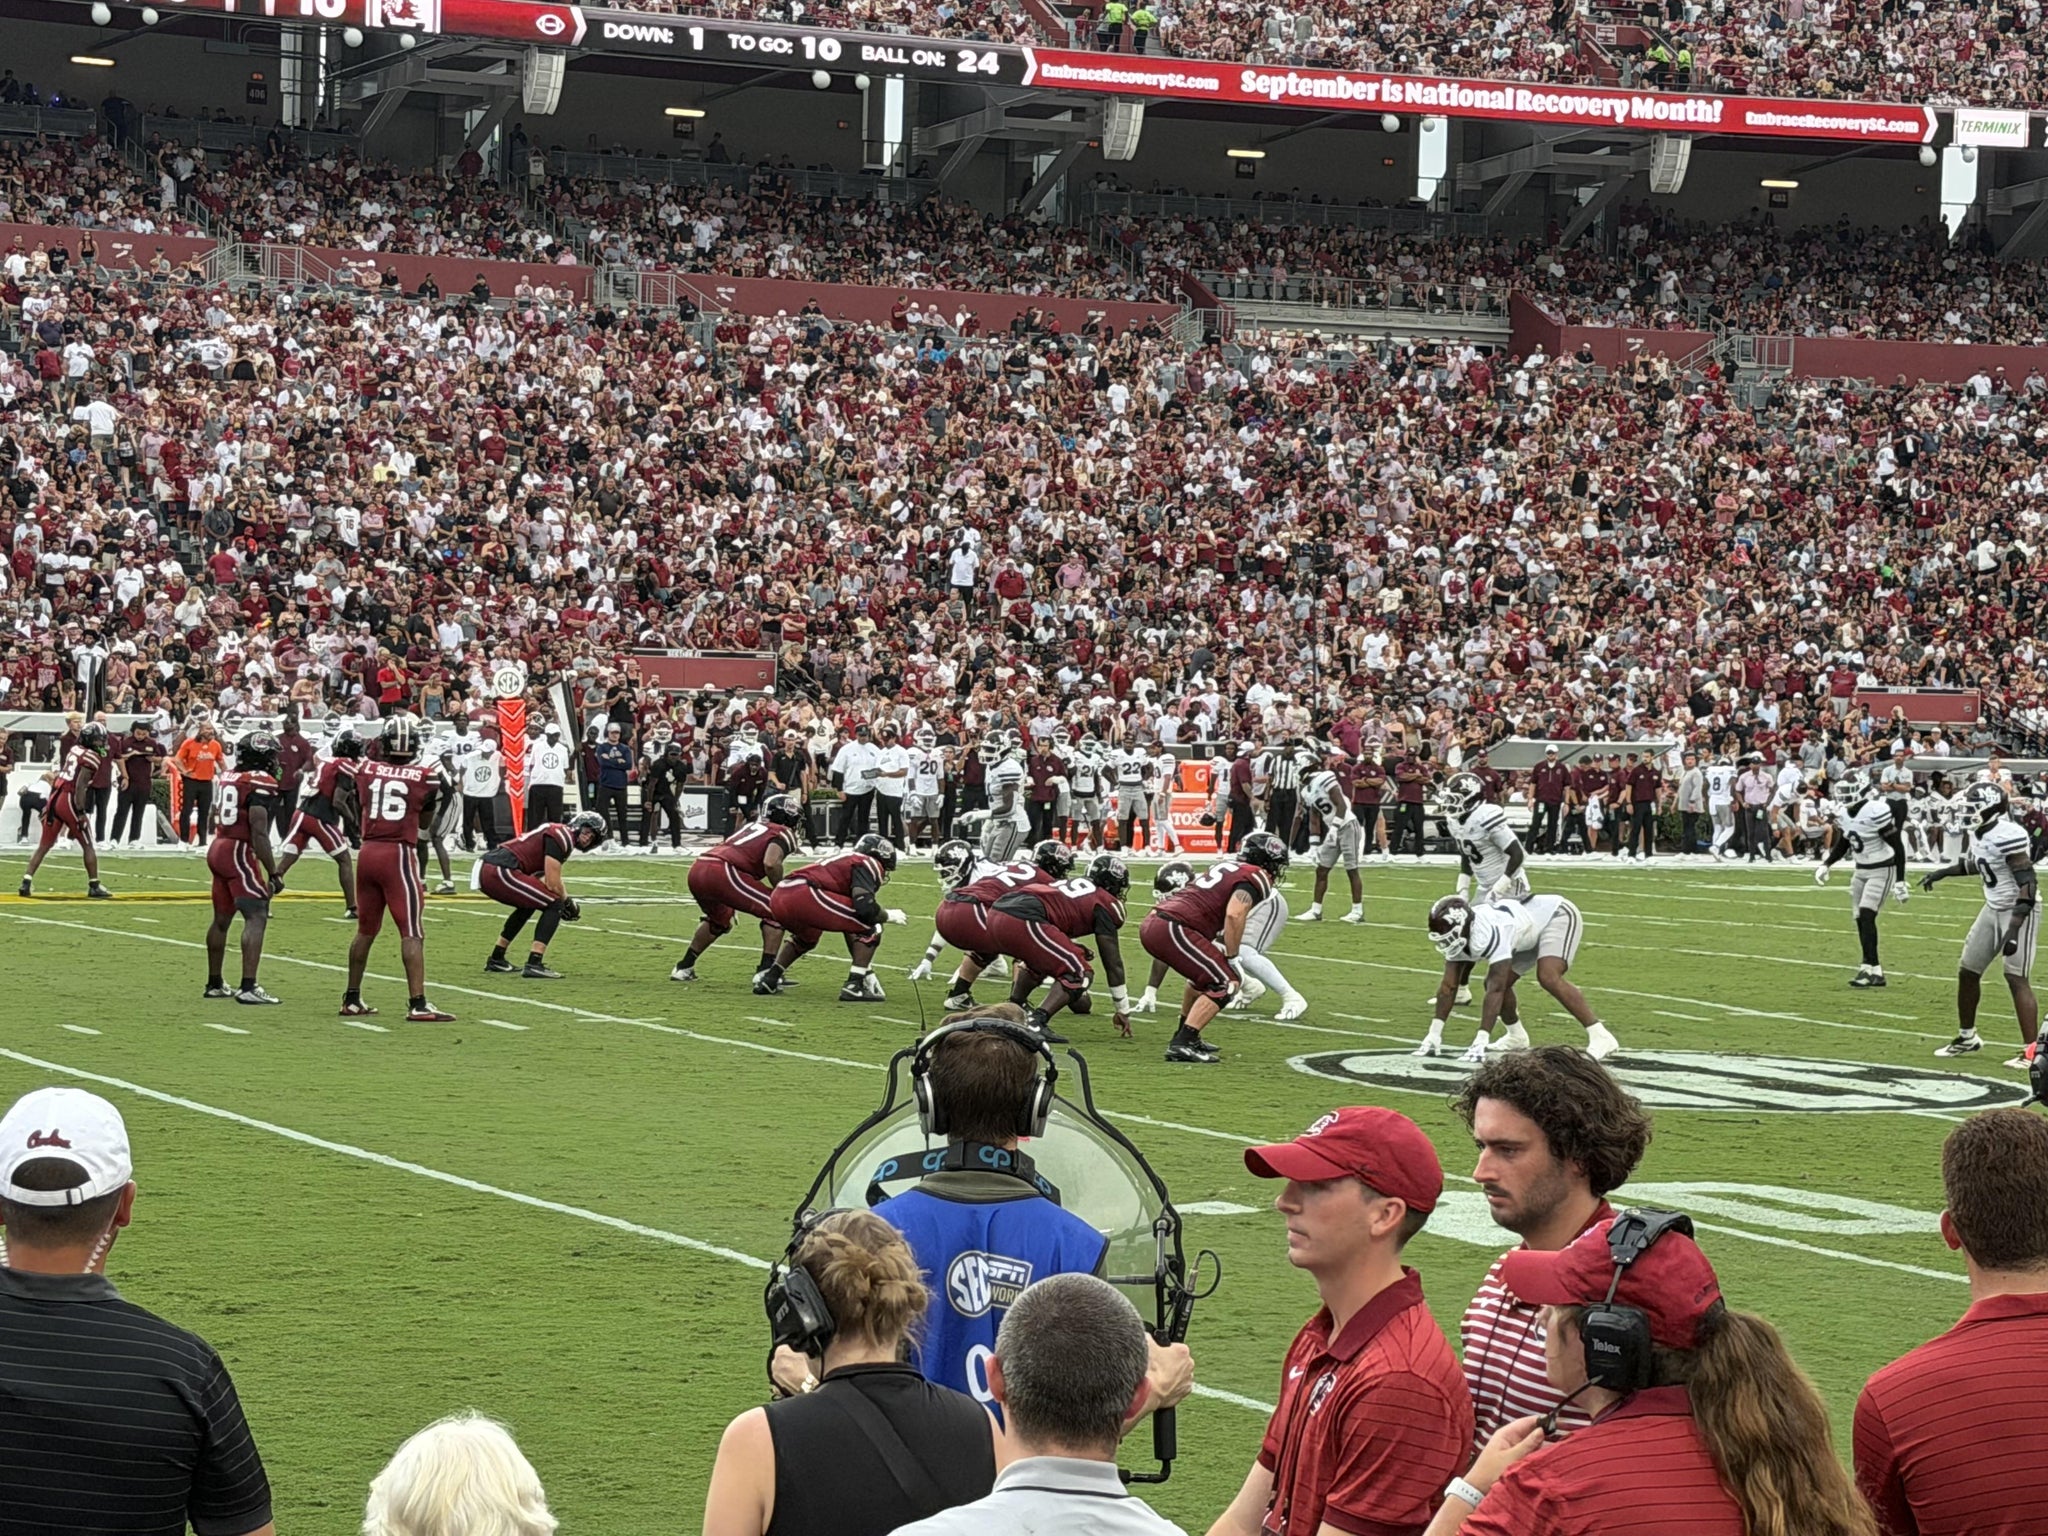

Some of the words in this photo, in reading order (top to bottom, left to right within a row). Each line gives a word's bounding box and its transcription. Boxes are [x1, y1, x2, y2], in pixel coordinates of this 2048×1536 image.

[603, 22, 674, 44] DOWN:
[689, 27, 704, 50] 1
[728, 33, 756, 50] TO
[758, 36, 794, 54] GO:
[801, 36, 842, 61] 10
[861, 45, 910, 64] BALL
[912, 49, 946, 67] ON:
[956, 49, 1000, 75] 24
[1041, 63, 1220, 90] EmbraceRecoverySC.com
[1240, 70, 1380, 101] September
[1380, 78, 1405, 103] is
[1405, 81, 1514, 111] National
[1515, 88, 1630, 124] Recovery
[1631, 96, 1724, 124] Month!
[1745, 111, 1919, 134] EmbraceRecoverySC.com
[1961, 120, 2022, 135] TERMINIX
[498, 672, 520, 694] SEC
[543, 753, 559, 769] SEC
[909, 760, 938, 775] 20
[1122, 762, 1141, 776] 22
[376, 763, 423, 782] SELLERS
[1712, 776, 1721, 791] 8
[368, 778, 409, 820] 16
[988, 1260, 1026, 1284] SPN
[950, 1255, 993, 1313] SEC
[1591, 1337, 1622, 1356] Telex
